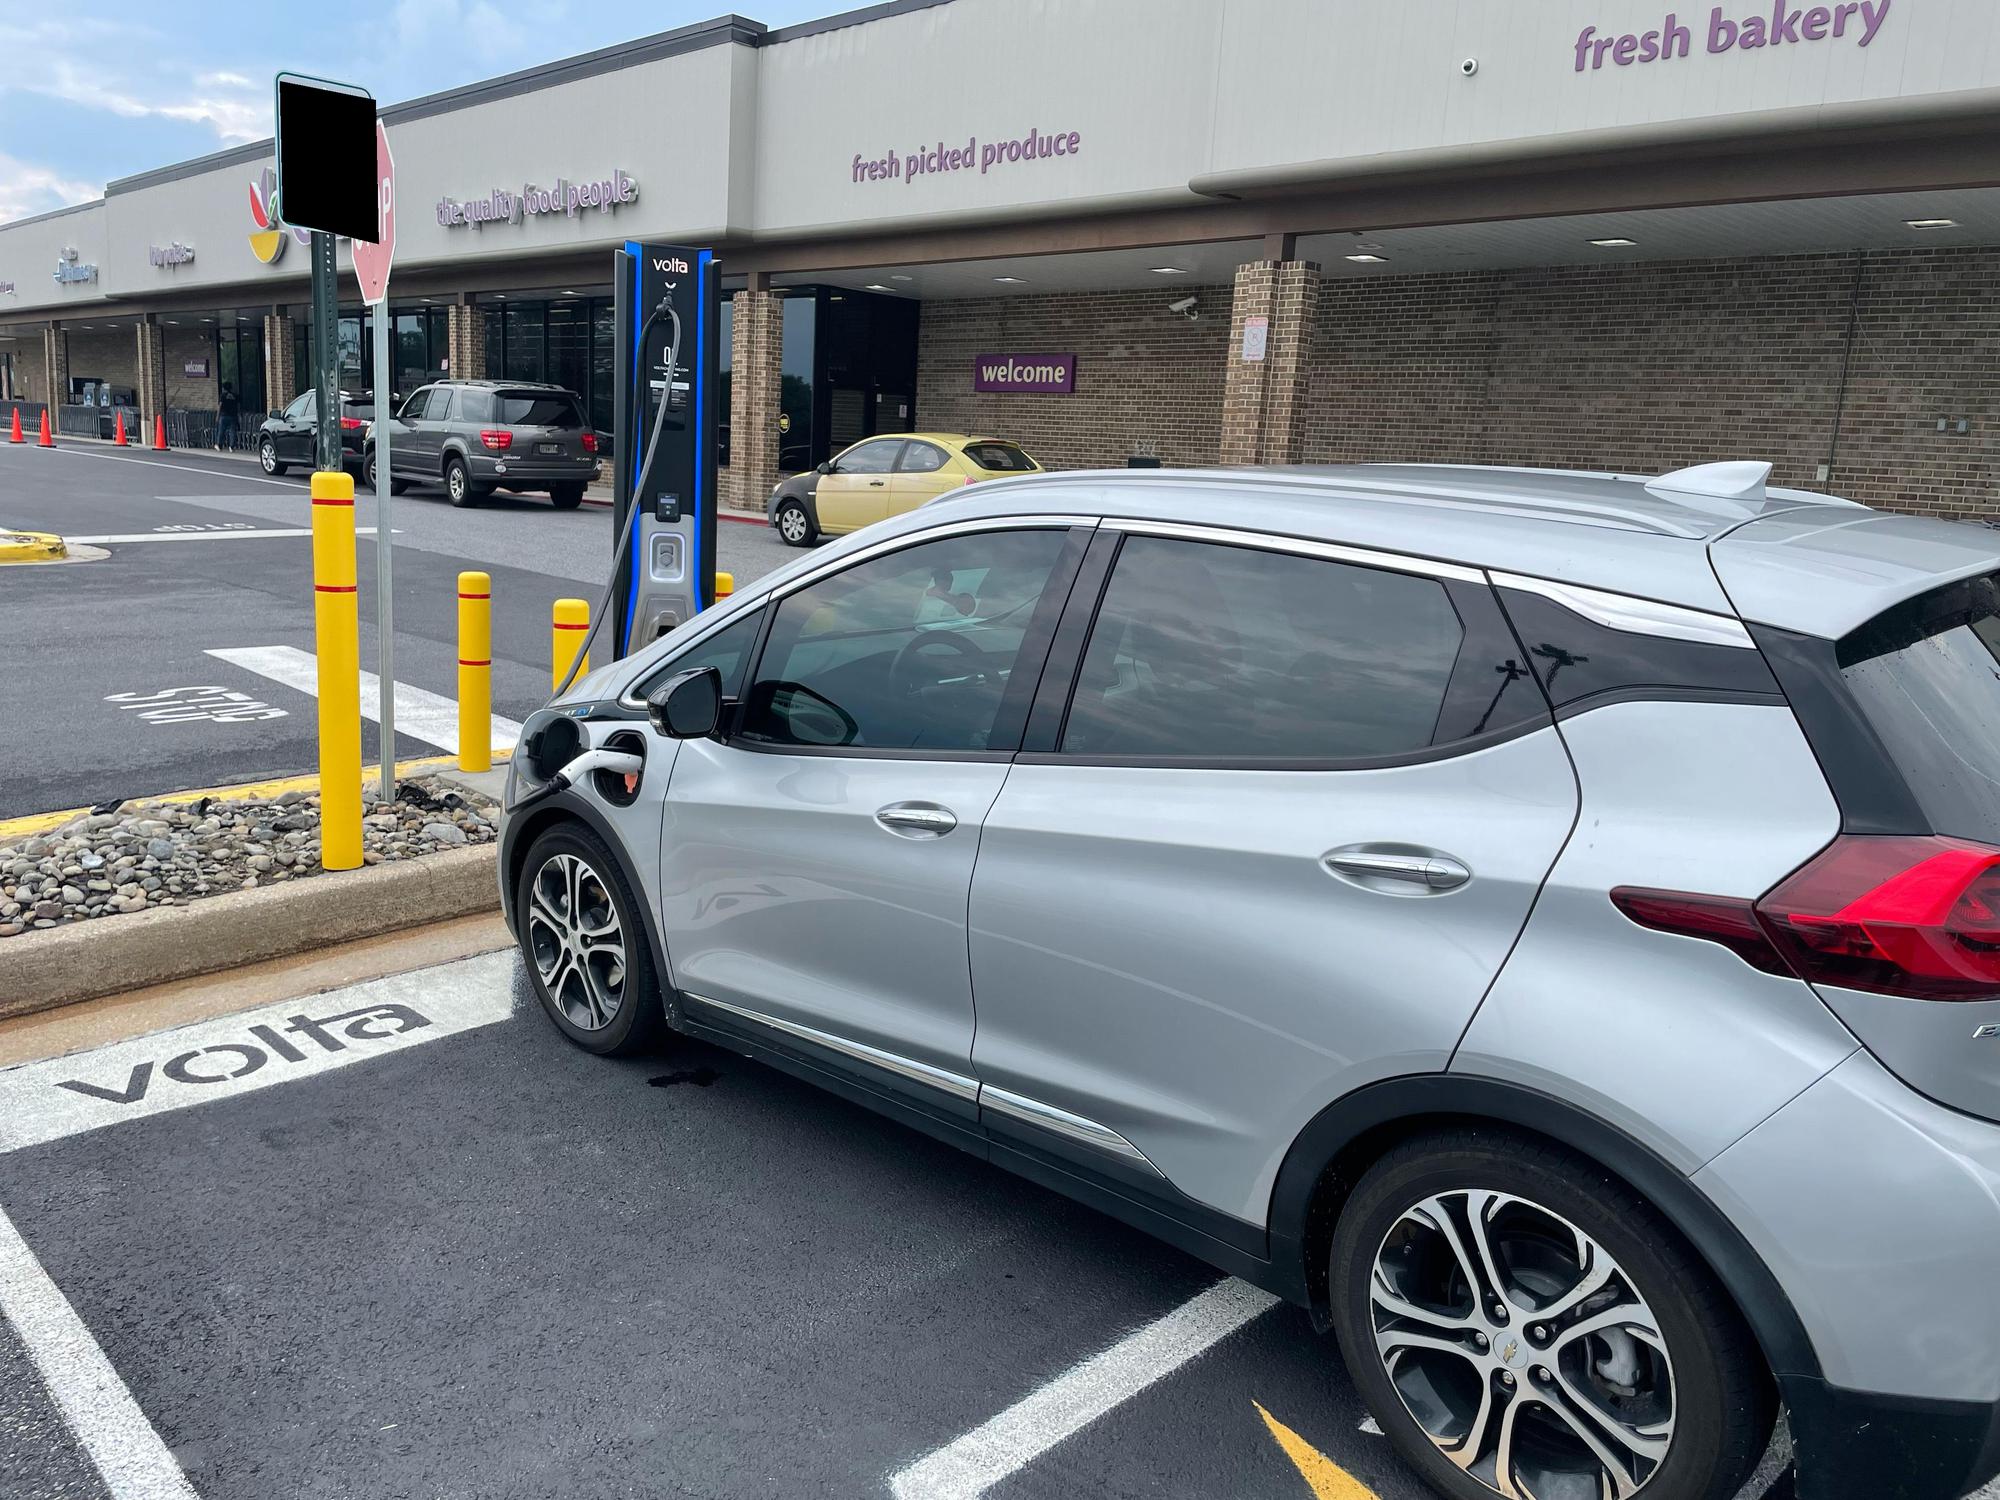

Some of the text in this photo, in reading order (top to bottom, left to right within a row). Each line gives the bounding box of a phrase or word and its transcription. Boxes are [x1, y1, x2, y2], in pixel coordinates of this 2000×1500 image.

[1574, 0, 1891, 72] fresh bakery
[852, 127, 1081, 184] fresh picked produce
[436, 197, 462, 226] the
[463, 188, 519, 231] quality
[523, 178, 562, 215] food
[567, 169, 631, 217] people
[652, 257, 689, 274] volta
[184, 360, 205, 374] welcome
[981, 358, 1066, 384] welcome
[103, 686, 290, 725] STOP
[53, 1003, 433, 1104] volta
